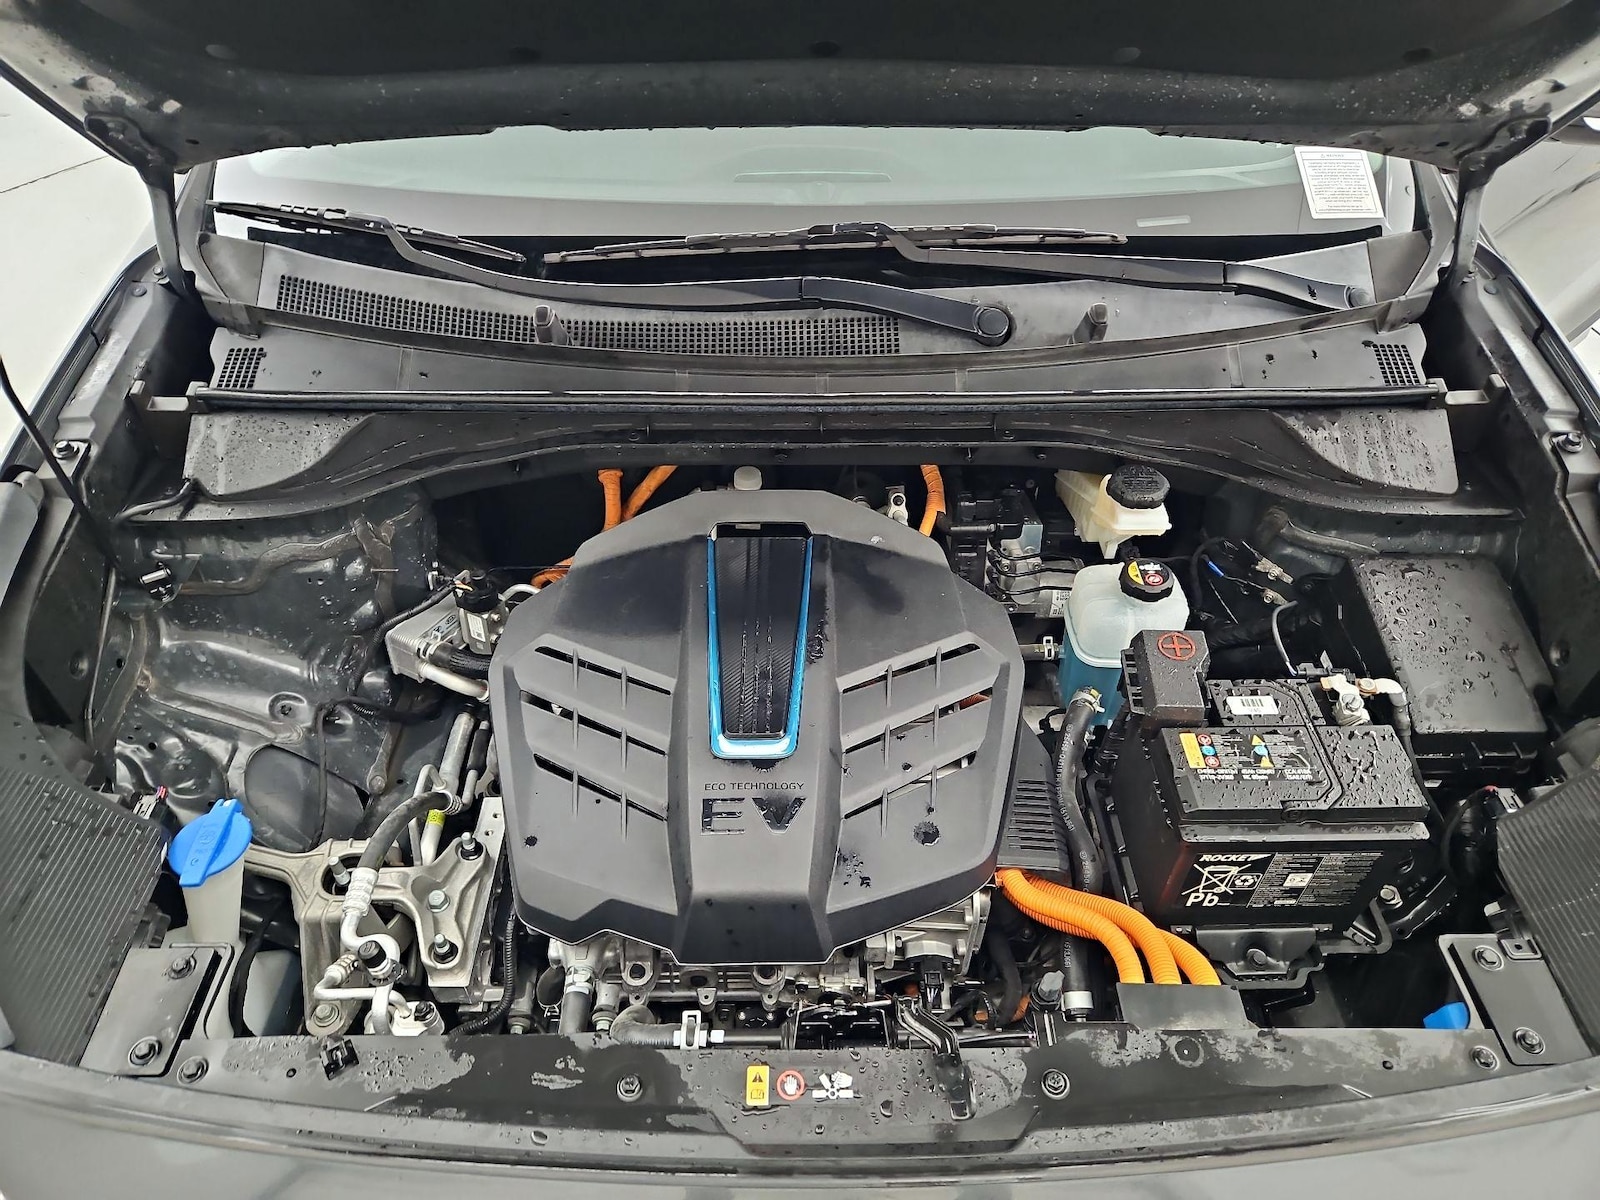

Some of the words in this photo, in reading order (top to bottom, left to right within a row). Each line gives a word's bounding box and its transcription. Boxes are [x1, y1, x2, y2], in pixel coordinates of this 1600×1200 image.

[704, 783, 726, 791] ECO
[730, 782, 805, 791] TECHNOLOGY
[701, 797, 807, 834] EV
[1199, 854, 1262, 862] ROCKET
[1185, 892, 1220, 907] Pb
